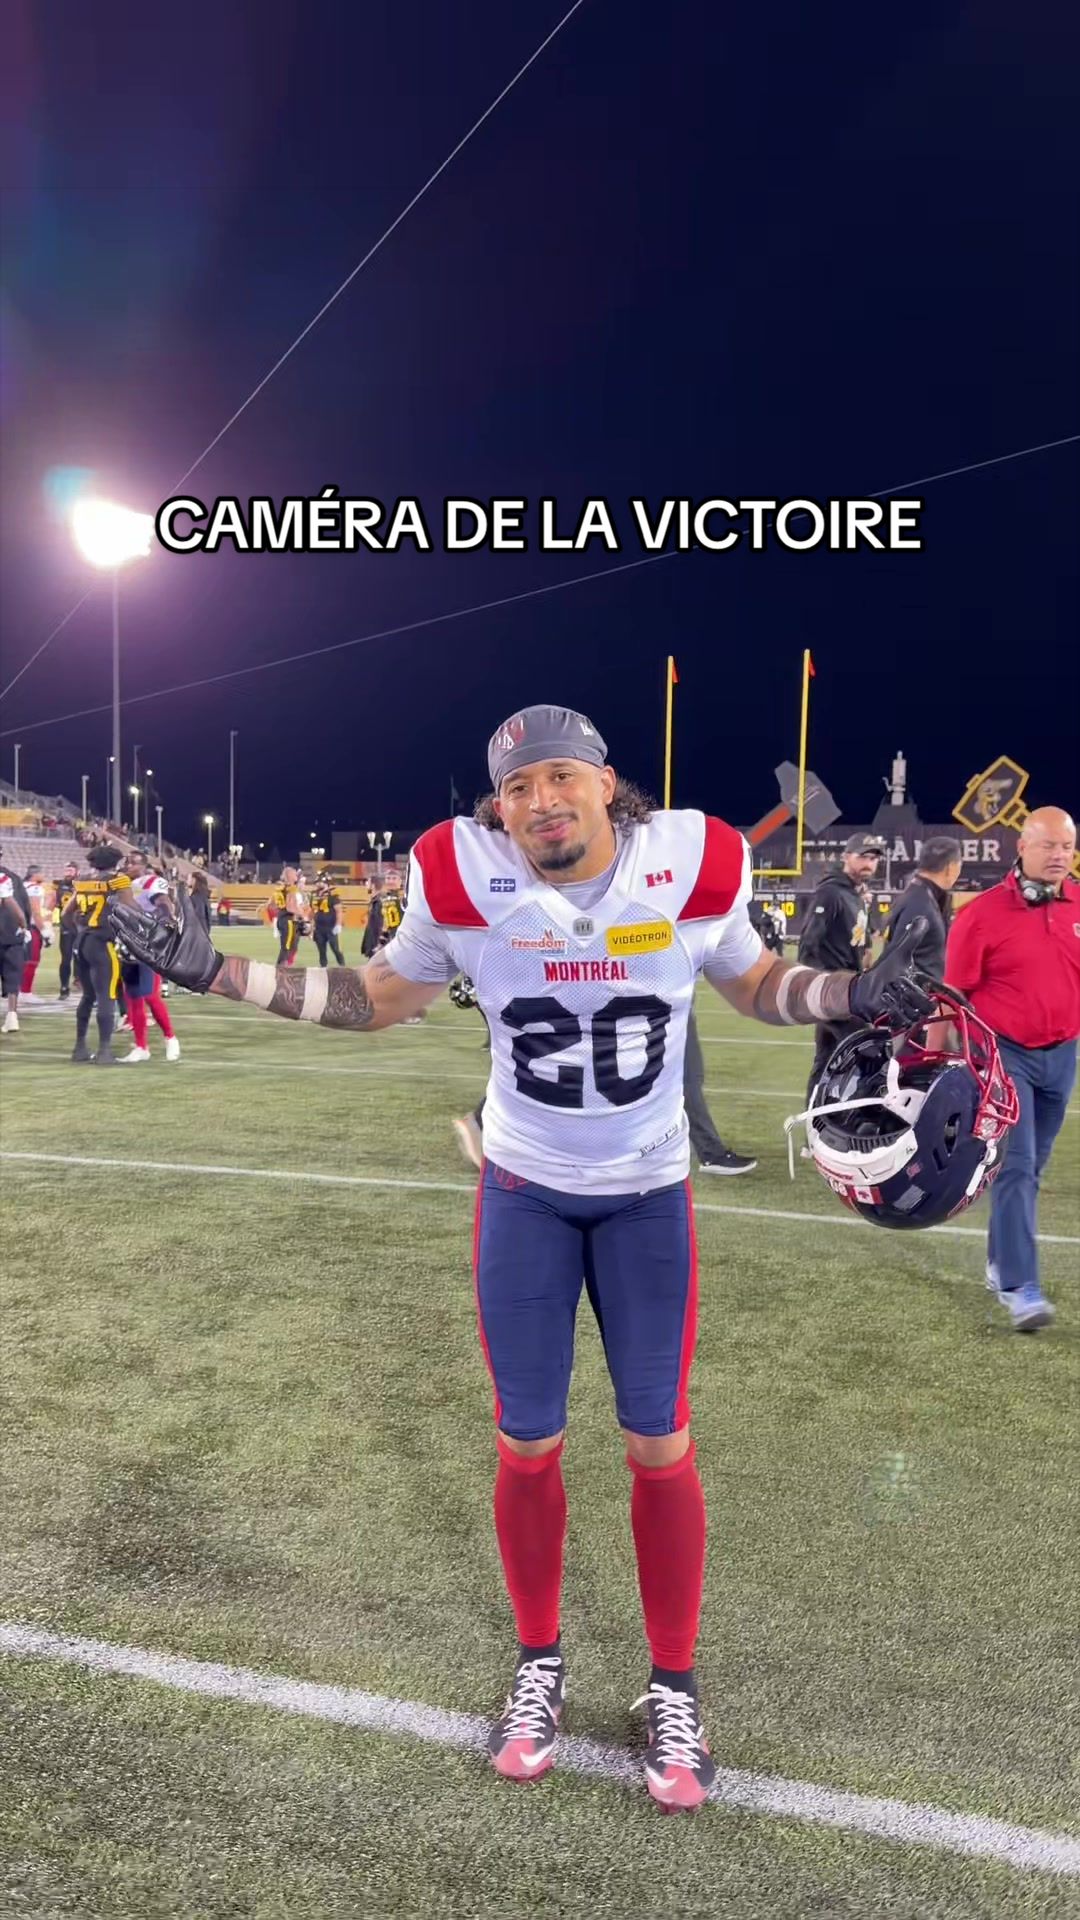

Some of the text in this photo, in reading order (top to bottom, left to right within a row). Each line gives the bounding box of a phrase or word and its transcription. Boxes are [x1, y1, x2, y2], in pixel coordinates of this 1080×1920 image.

[613, 930, 668, 946] VIDÉOTRON
[543, 956, 629, 982] MONTRÉAL
[501, 994, 672, 1108] 20
